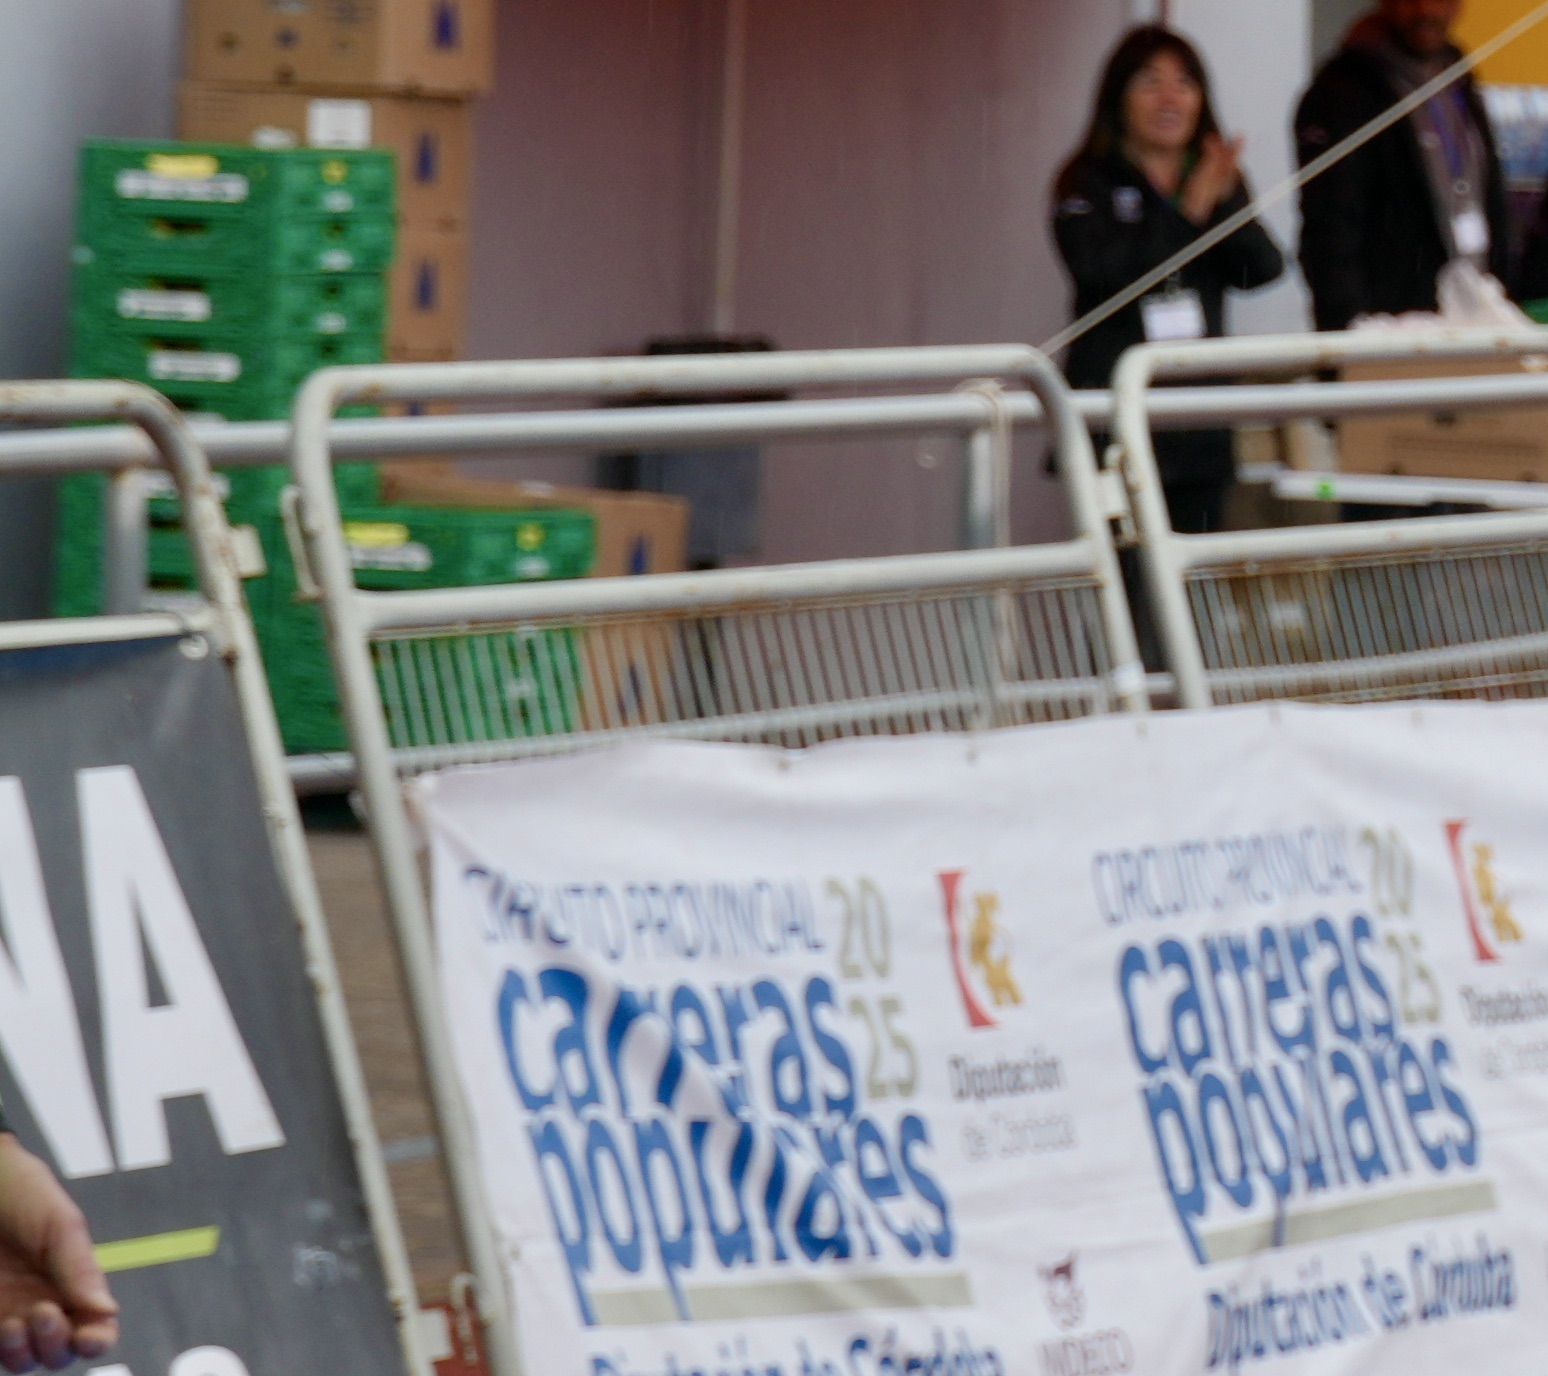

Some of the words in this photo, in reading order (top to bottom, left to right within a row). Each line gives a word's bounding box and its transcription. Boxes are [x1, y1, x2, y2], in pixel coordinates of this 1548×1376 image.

[847, 996, 918, 1099] 25
[1118, 913, 1396, 1078] carreras
[526, 1111, 957, 1328] populares
[1141, 1037, 1480, 1266] populares
